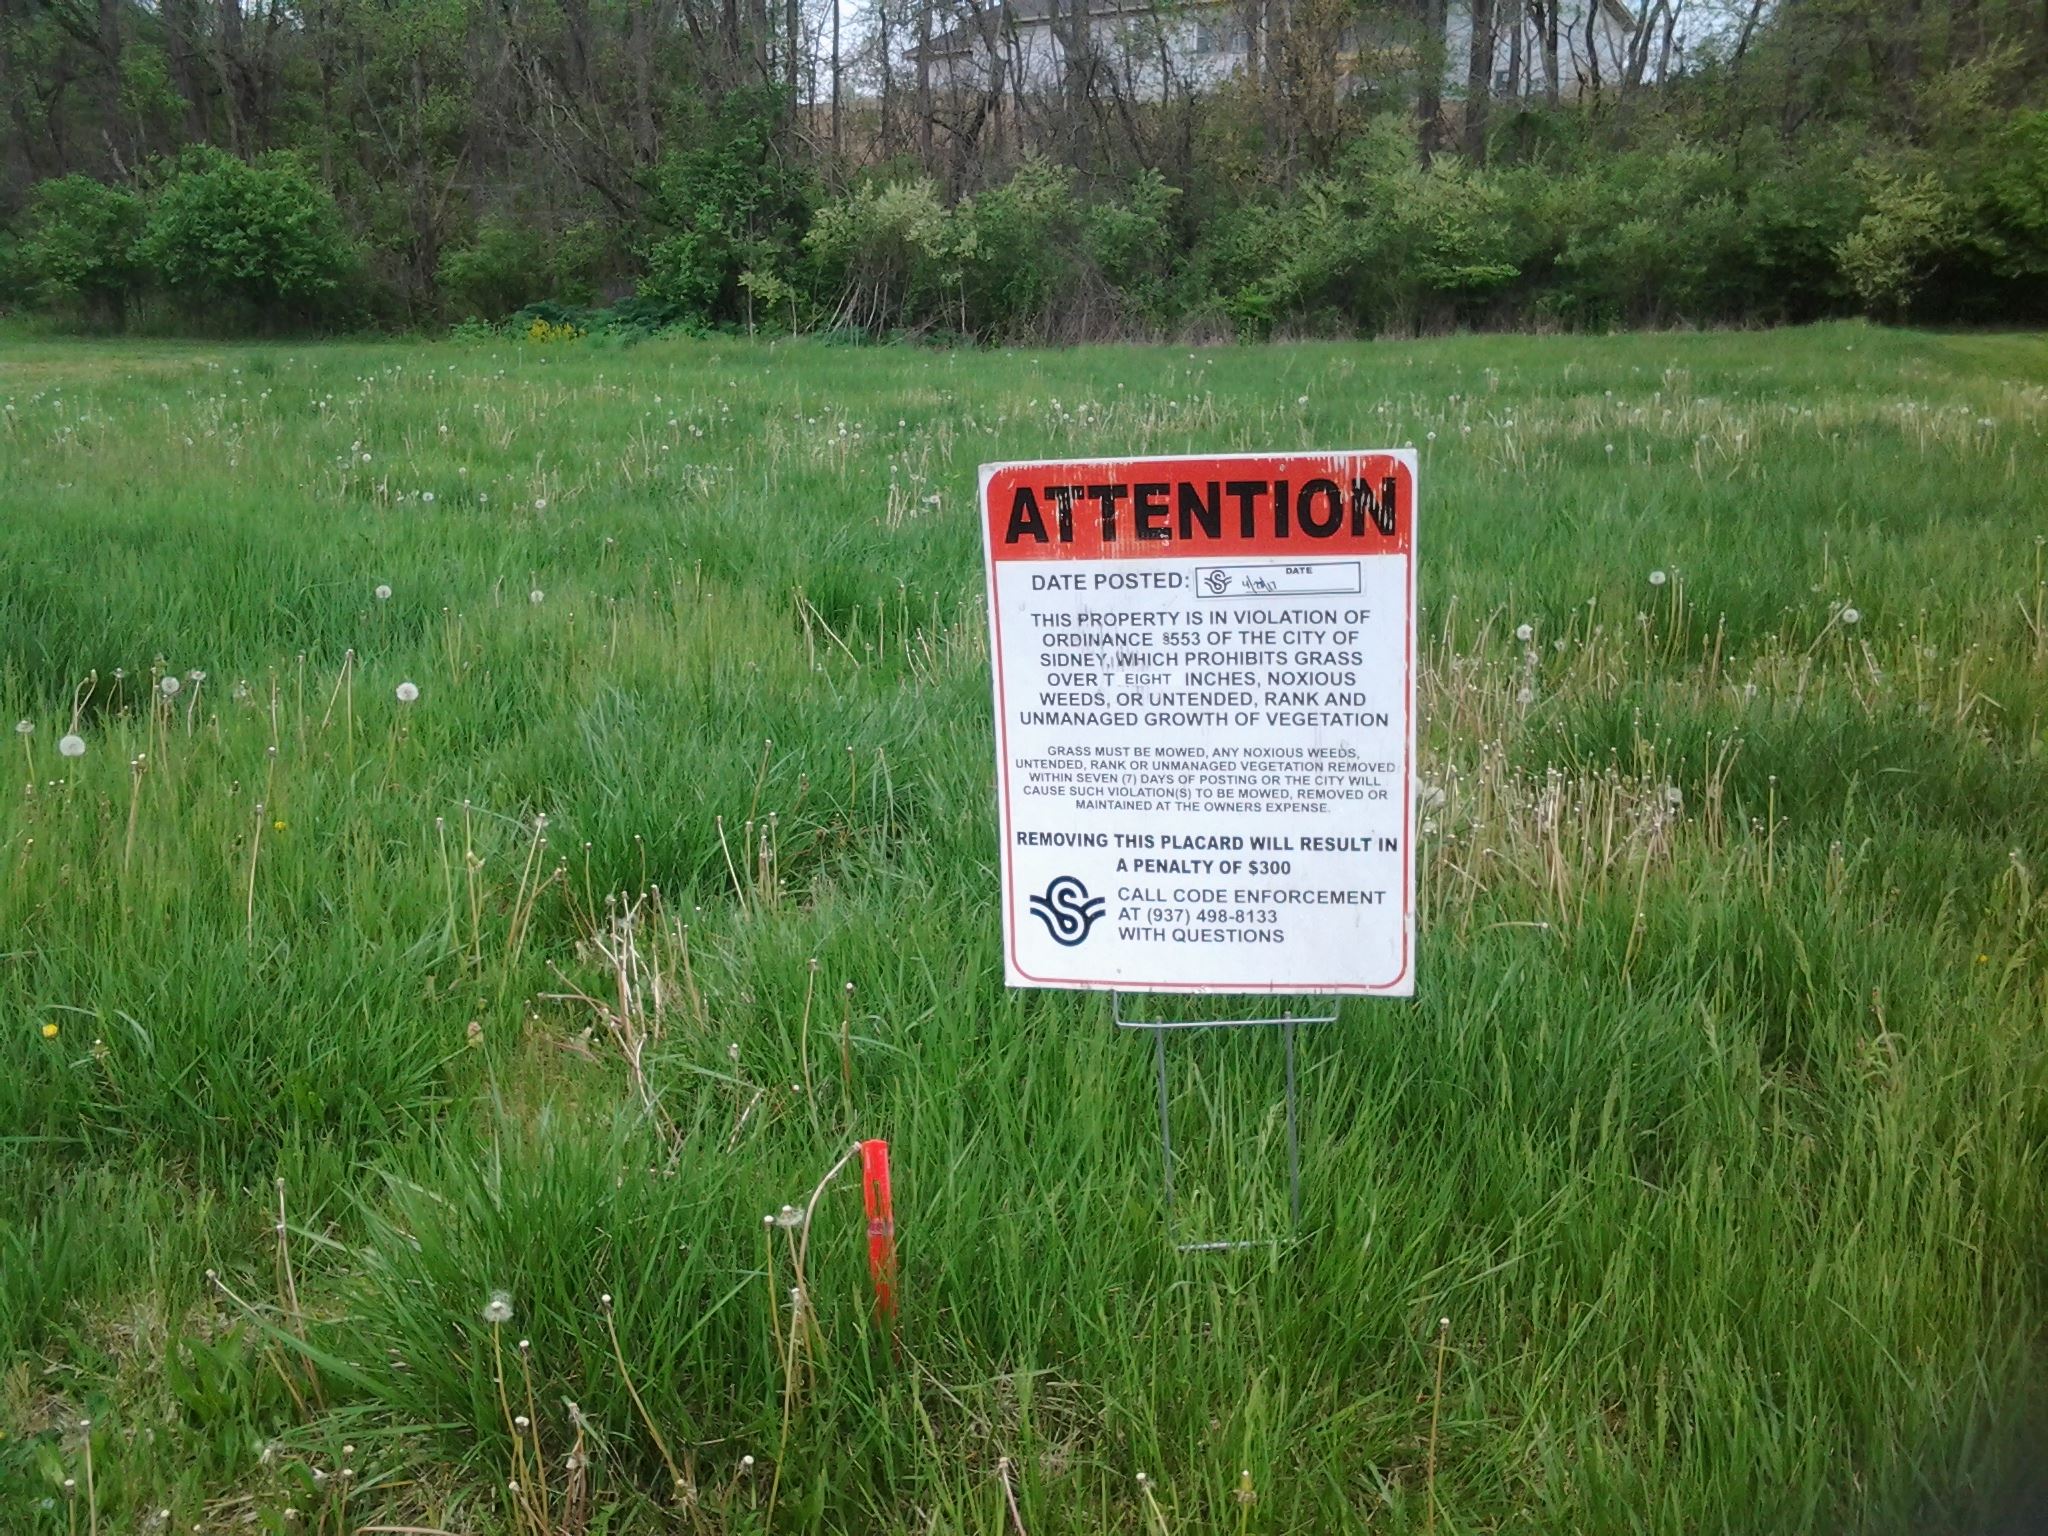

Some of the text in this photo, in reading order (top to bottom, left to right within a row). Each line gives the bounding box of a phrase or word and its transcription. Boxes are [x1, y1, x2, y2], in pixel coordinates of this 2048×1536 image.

[1005, 477, 1397, 544] ATTENTION
[1285, 567, 1312, 575] DATE
[1032, 572, 1189, 590] DATE POSTED:
[1031, 610, 1370, 627] THIS PROPERTY IS IN VIOLATION OF
[1043, 633, 1153, 647] ORDINANCE
[1207, 631, 1232, 645] OF
[1240, 632, 1276, 645] THE
[1283, 631, 1326, 644] CITY
[1333, 631, 1359, 645] OF
[1116, 652, 1178, 666] WHICH
[1186, 651, 1287, 665] PROHIBITS
[1295, 651, 1362, 665] GRASS
[1048, 673, 1098, 686] OVER
[1125, 674, 1171, 687] EIGHT
[1186, 672, 1260, 687] INCHES,
[1268, 672, 1356, 686] NOXIOUS
[1040, 692, 1366, 709] WEEDS, OR UNTENDED, RANK AND
[1021, 712, 1388, 726] UNMANAGED GROWTH OF VEGETATION
[1048, 746, 1359, 759] GRASS MUST BE MOWED, ANY NOXIOUS WEEDS,
[1015, 759, 1395, 773] UNTENDED, RANK OR UNMANAGED VEGETATION REMOVED
[1029, 773, 1381, 786] WITHIN SEVEN (7) DAYS OF POSTING OR THE CITY WILL
[1023, 786, 1387, 801] CAUSE SUCH VIOLATION(S) TO BE MOWED, REMOVED OR
[1076, 800, 1331, 813] MAINTAINED AT THE OWNERS EXPENSE.
[1017, 832, 1397, 851] REMOVING THIS PLACARD WILL RESULT IN
[1117, 858, 1290, 875] A PENALTY OF $300
[1118, 887, 1386, 904] CALL CODE ENFORCEMENT
[1119, 907, 1277, 925] AT (937) 498-8133
[1119, 928, 1284, 943] WITH QUESTIONS
